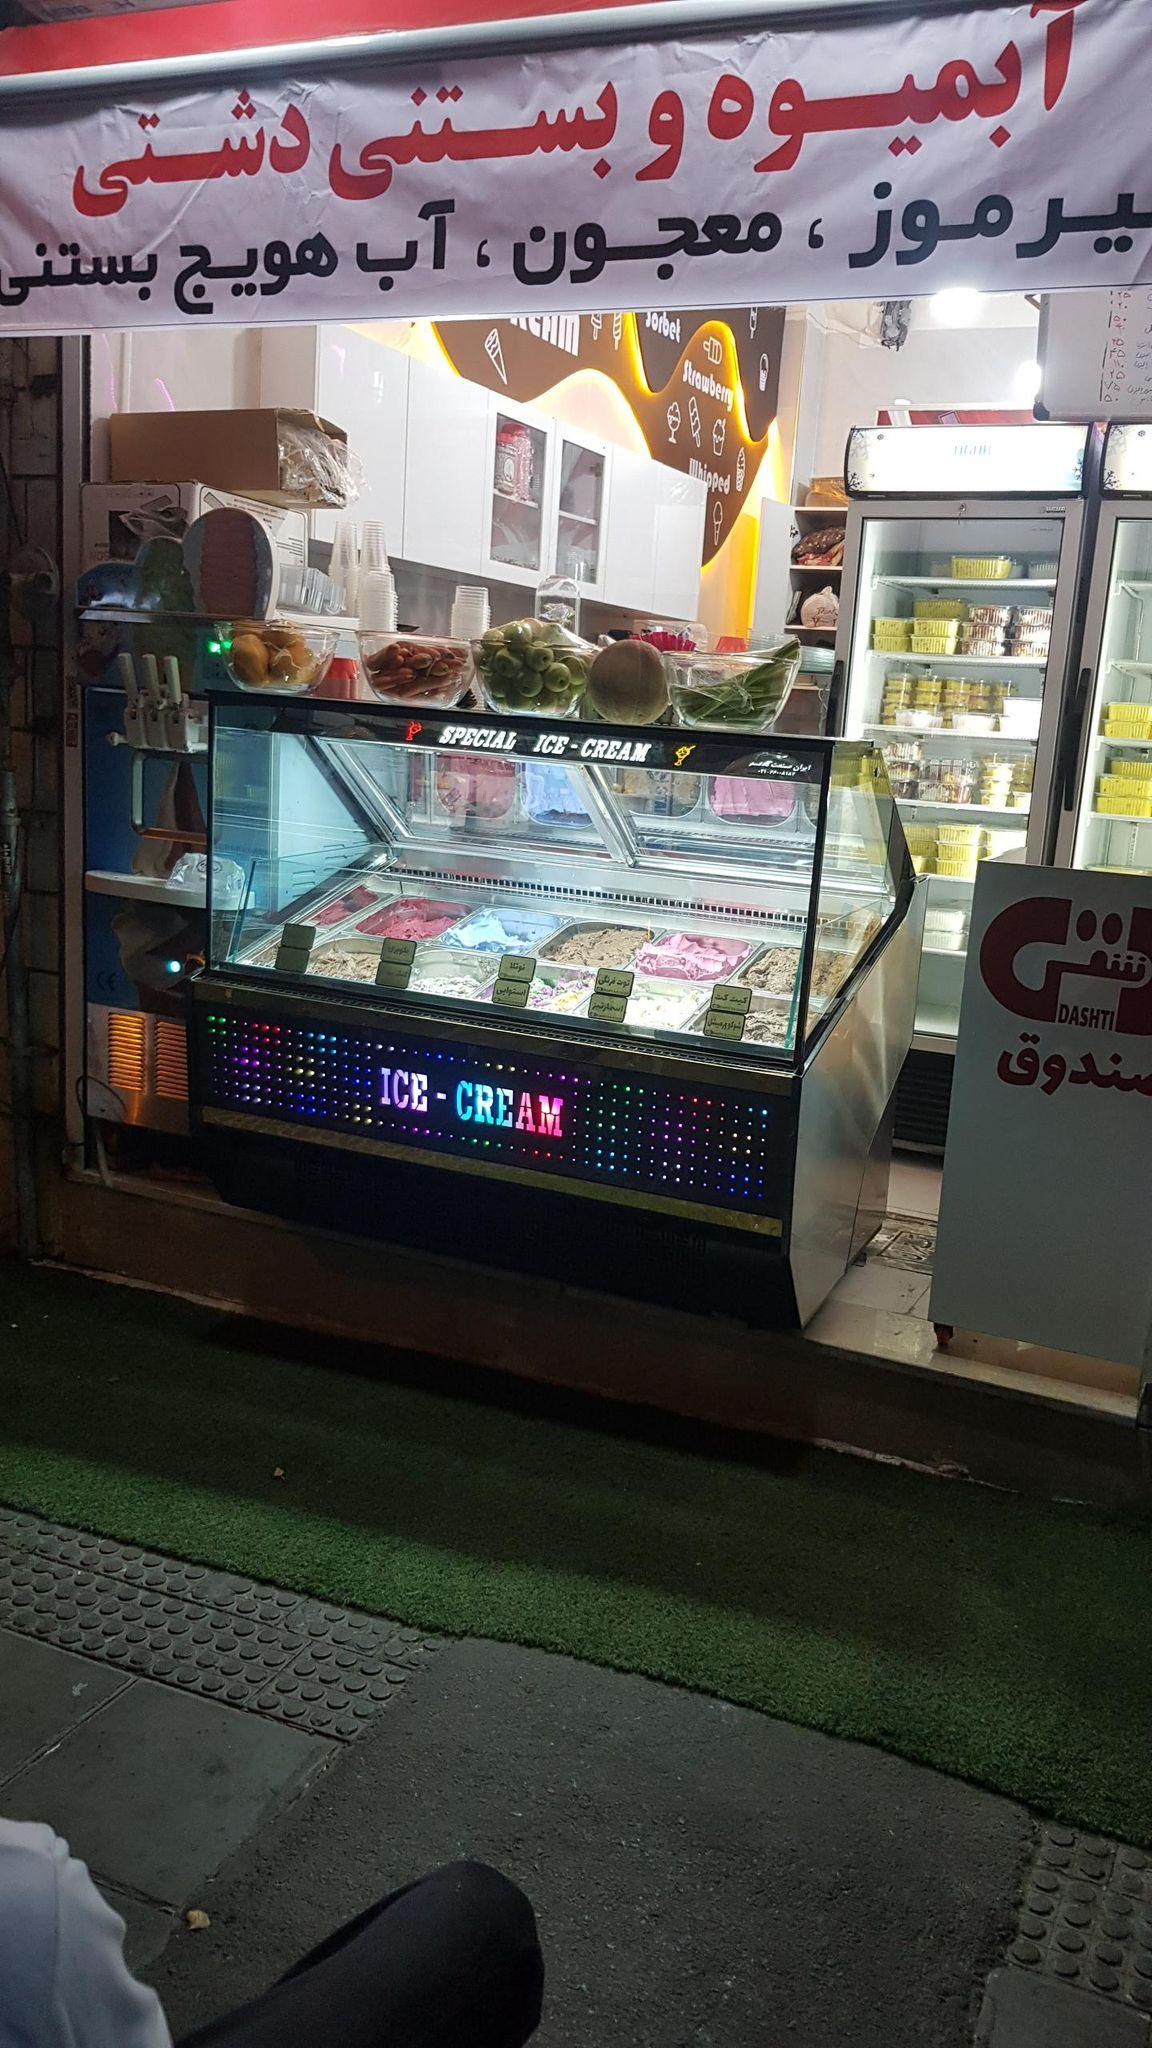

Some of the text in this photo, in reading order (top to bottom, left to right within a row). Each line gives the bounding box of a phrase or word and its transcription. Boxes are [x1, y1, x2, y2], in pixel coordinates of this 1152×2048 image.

[72, 0, 1087, 217] آبمیوه و بستنی دشتی
[356, 199, 455, 291] آب
[513, 211, 782, 285] معجون
[849, 182, 1013, 269] موز
[1016, 192, 1152, 259] یر
[174, 231, 338, 315] هویج
[683, 360, 734, 412] Strawberry
[688, 458, 730, 494] Whipped
[439, 726, 517, 750] SPECIAL
[1058, 1003, 1115, 1031] DASHTI
[380, 1067, 428, 1112] ICE
[456, 1080, 563, 1137] CREAM
